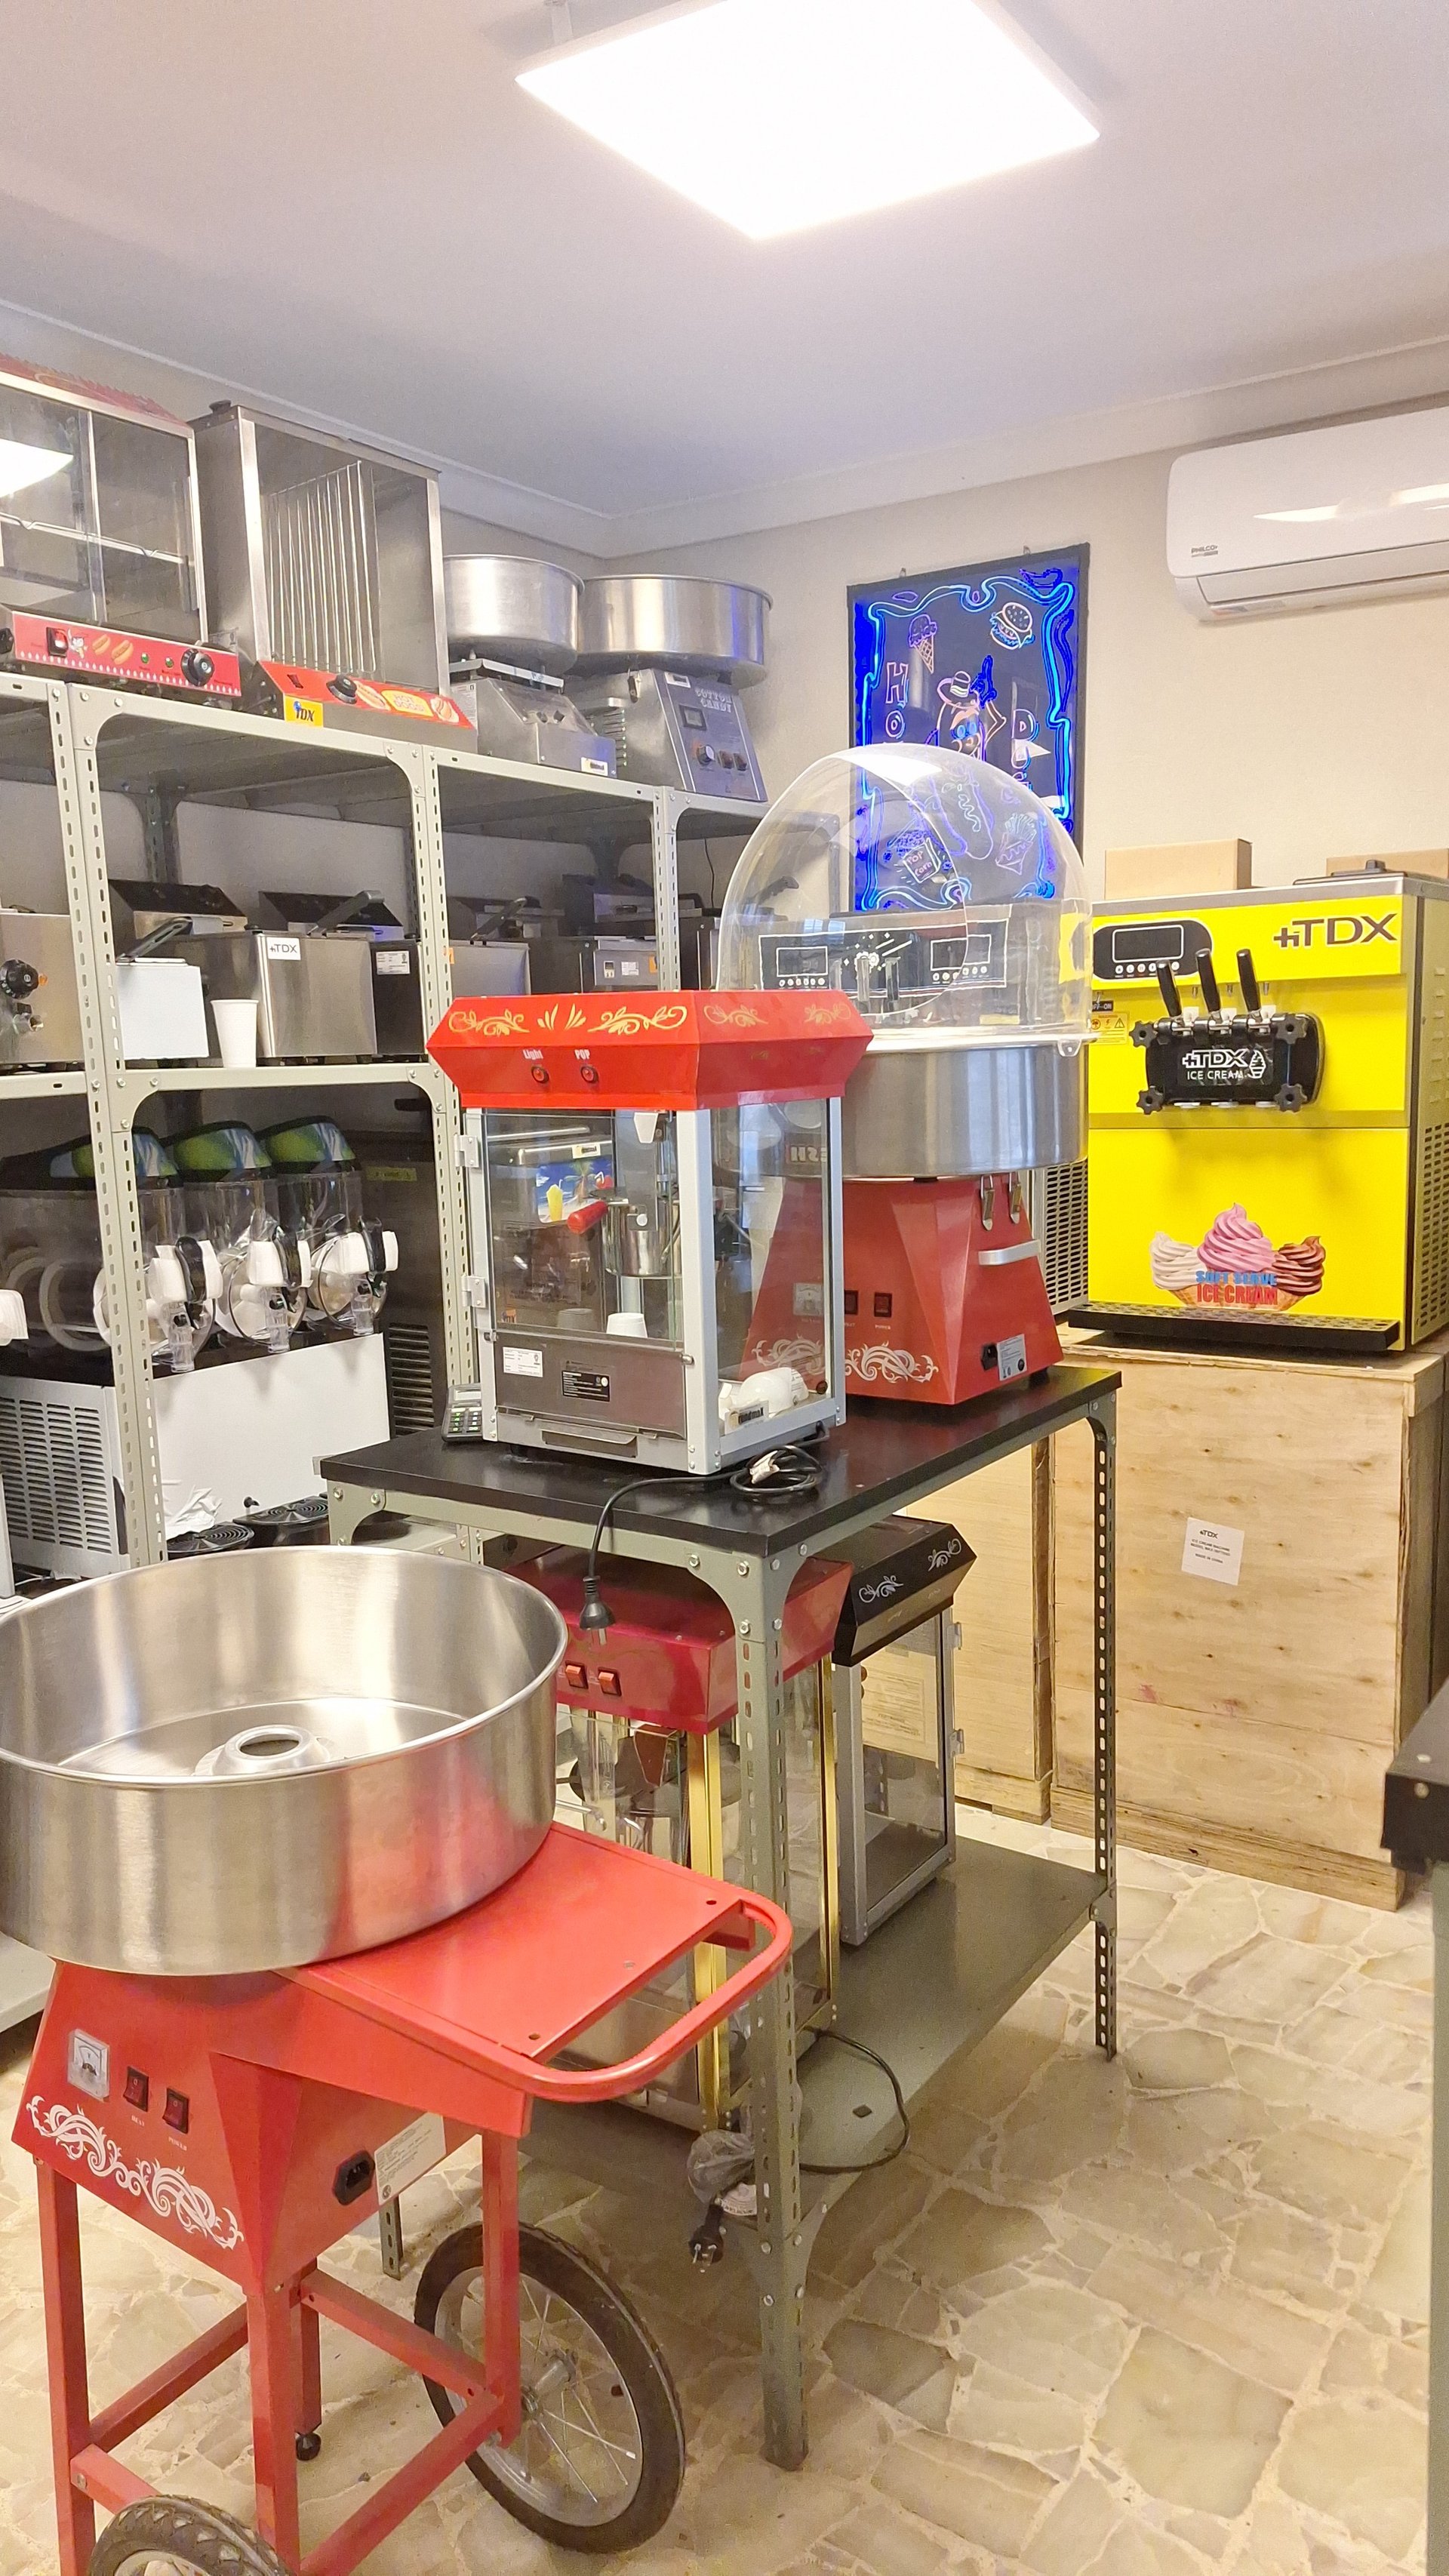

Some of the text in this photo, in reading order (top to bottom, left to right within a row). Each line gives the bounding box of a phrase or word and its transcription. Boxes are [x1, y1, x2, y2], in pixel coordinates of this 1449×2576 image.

[1187, 1070, 1244, 1080] ICE CREAM
[1197, 1284, 1278, 1305] ICE CREAM
